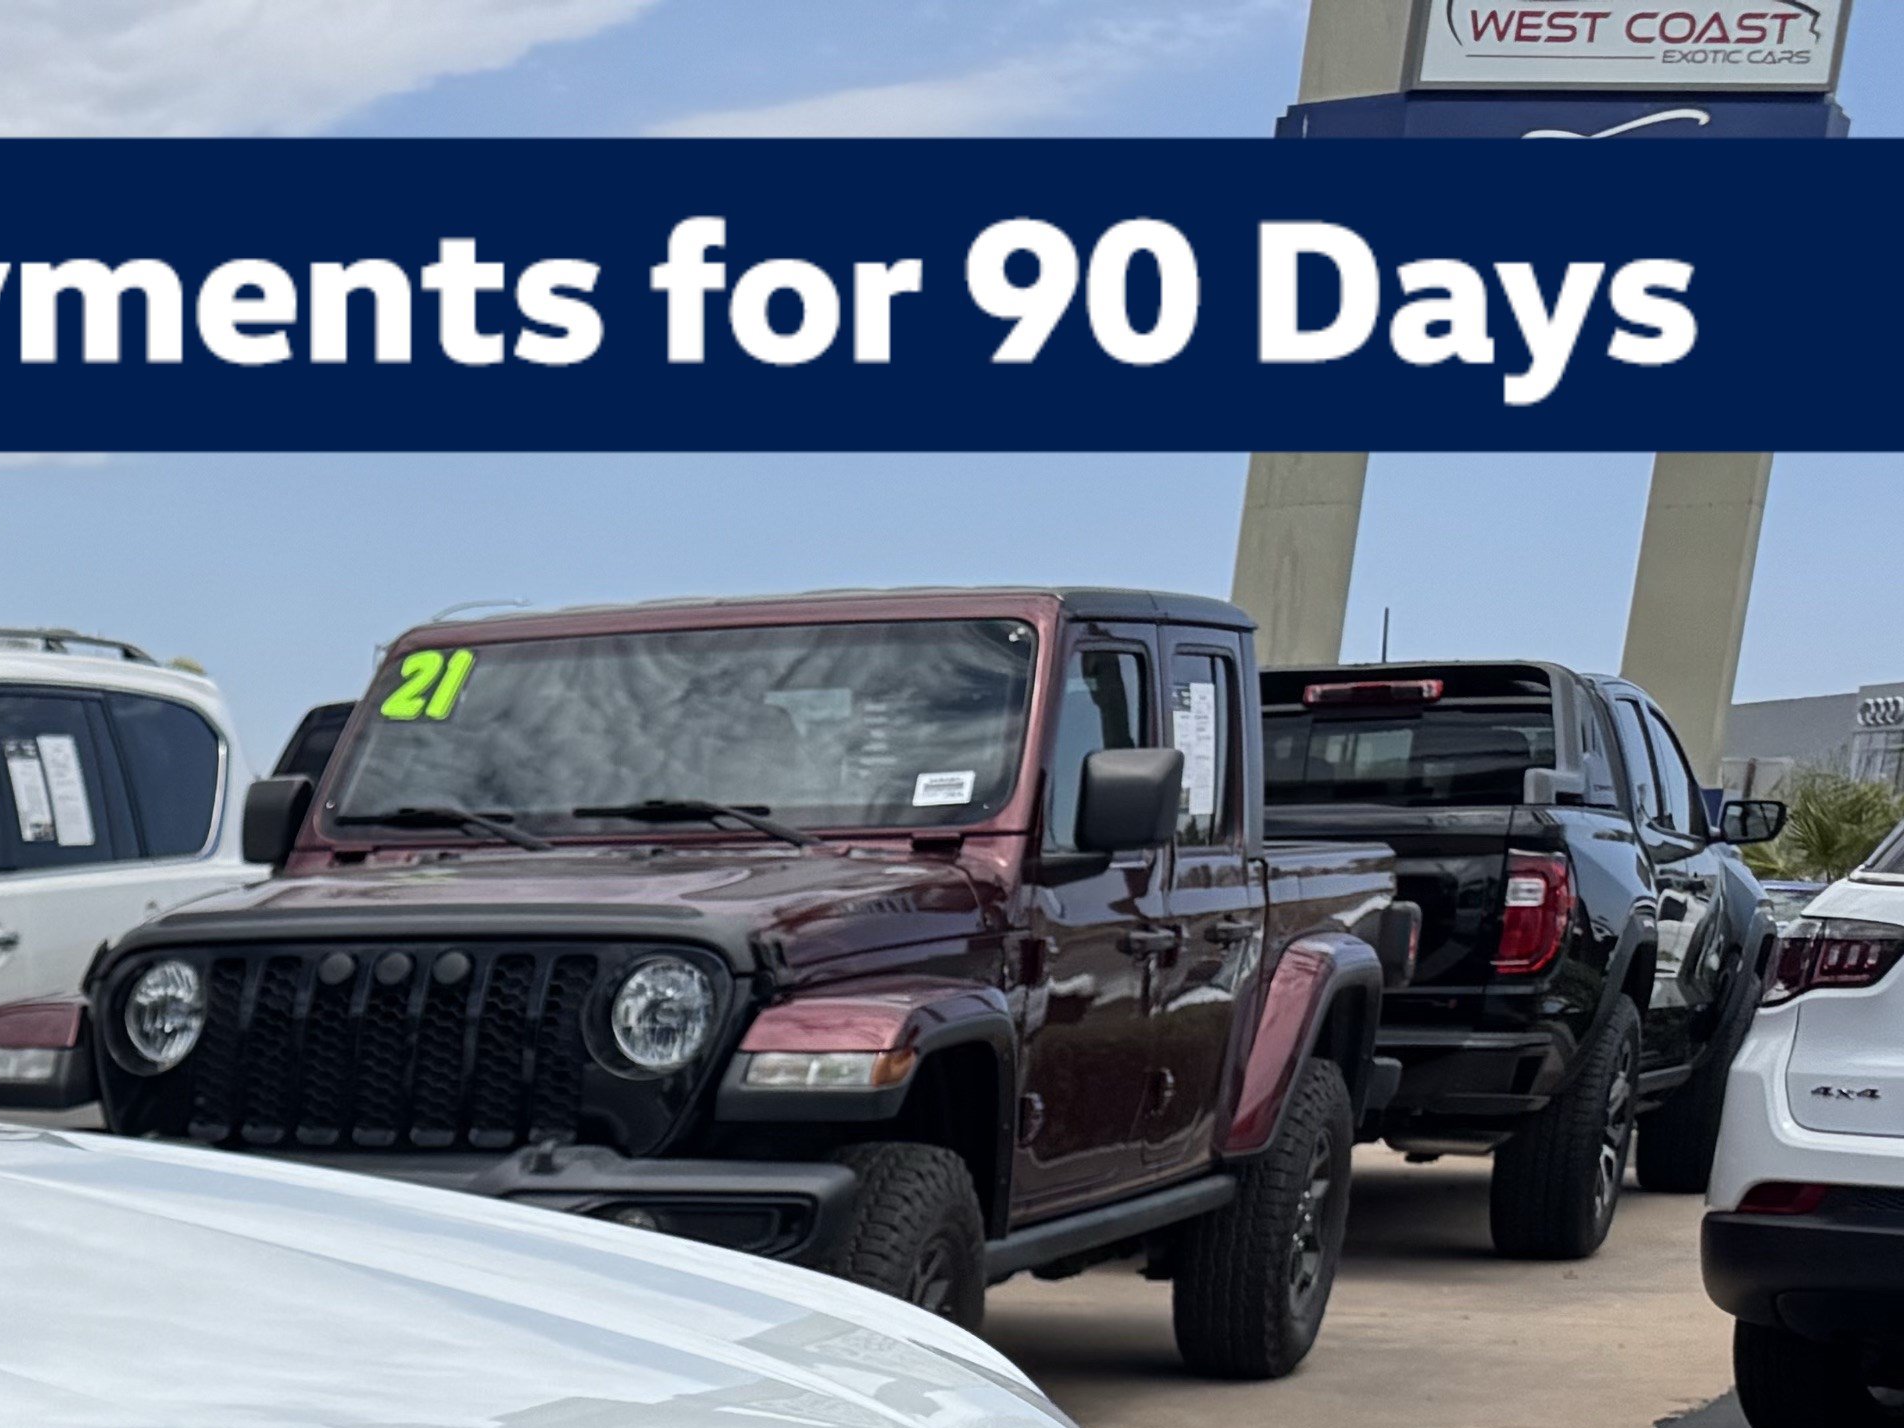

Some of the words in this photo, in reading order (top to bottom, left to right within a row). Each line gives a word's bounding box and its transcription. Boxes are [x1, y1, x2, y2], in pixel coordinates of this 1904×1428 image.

[1470, 10, 1612, 44] WEST
[1625, 11, 1802, 45] COAST
[1662, 50, 1740, 64] EXOTIC
[1747, 50, 1810, 64] CARS
[380, 648, 474, 720] 21
